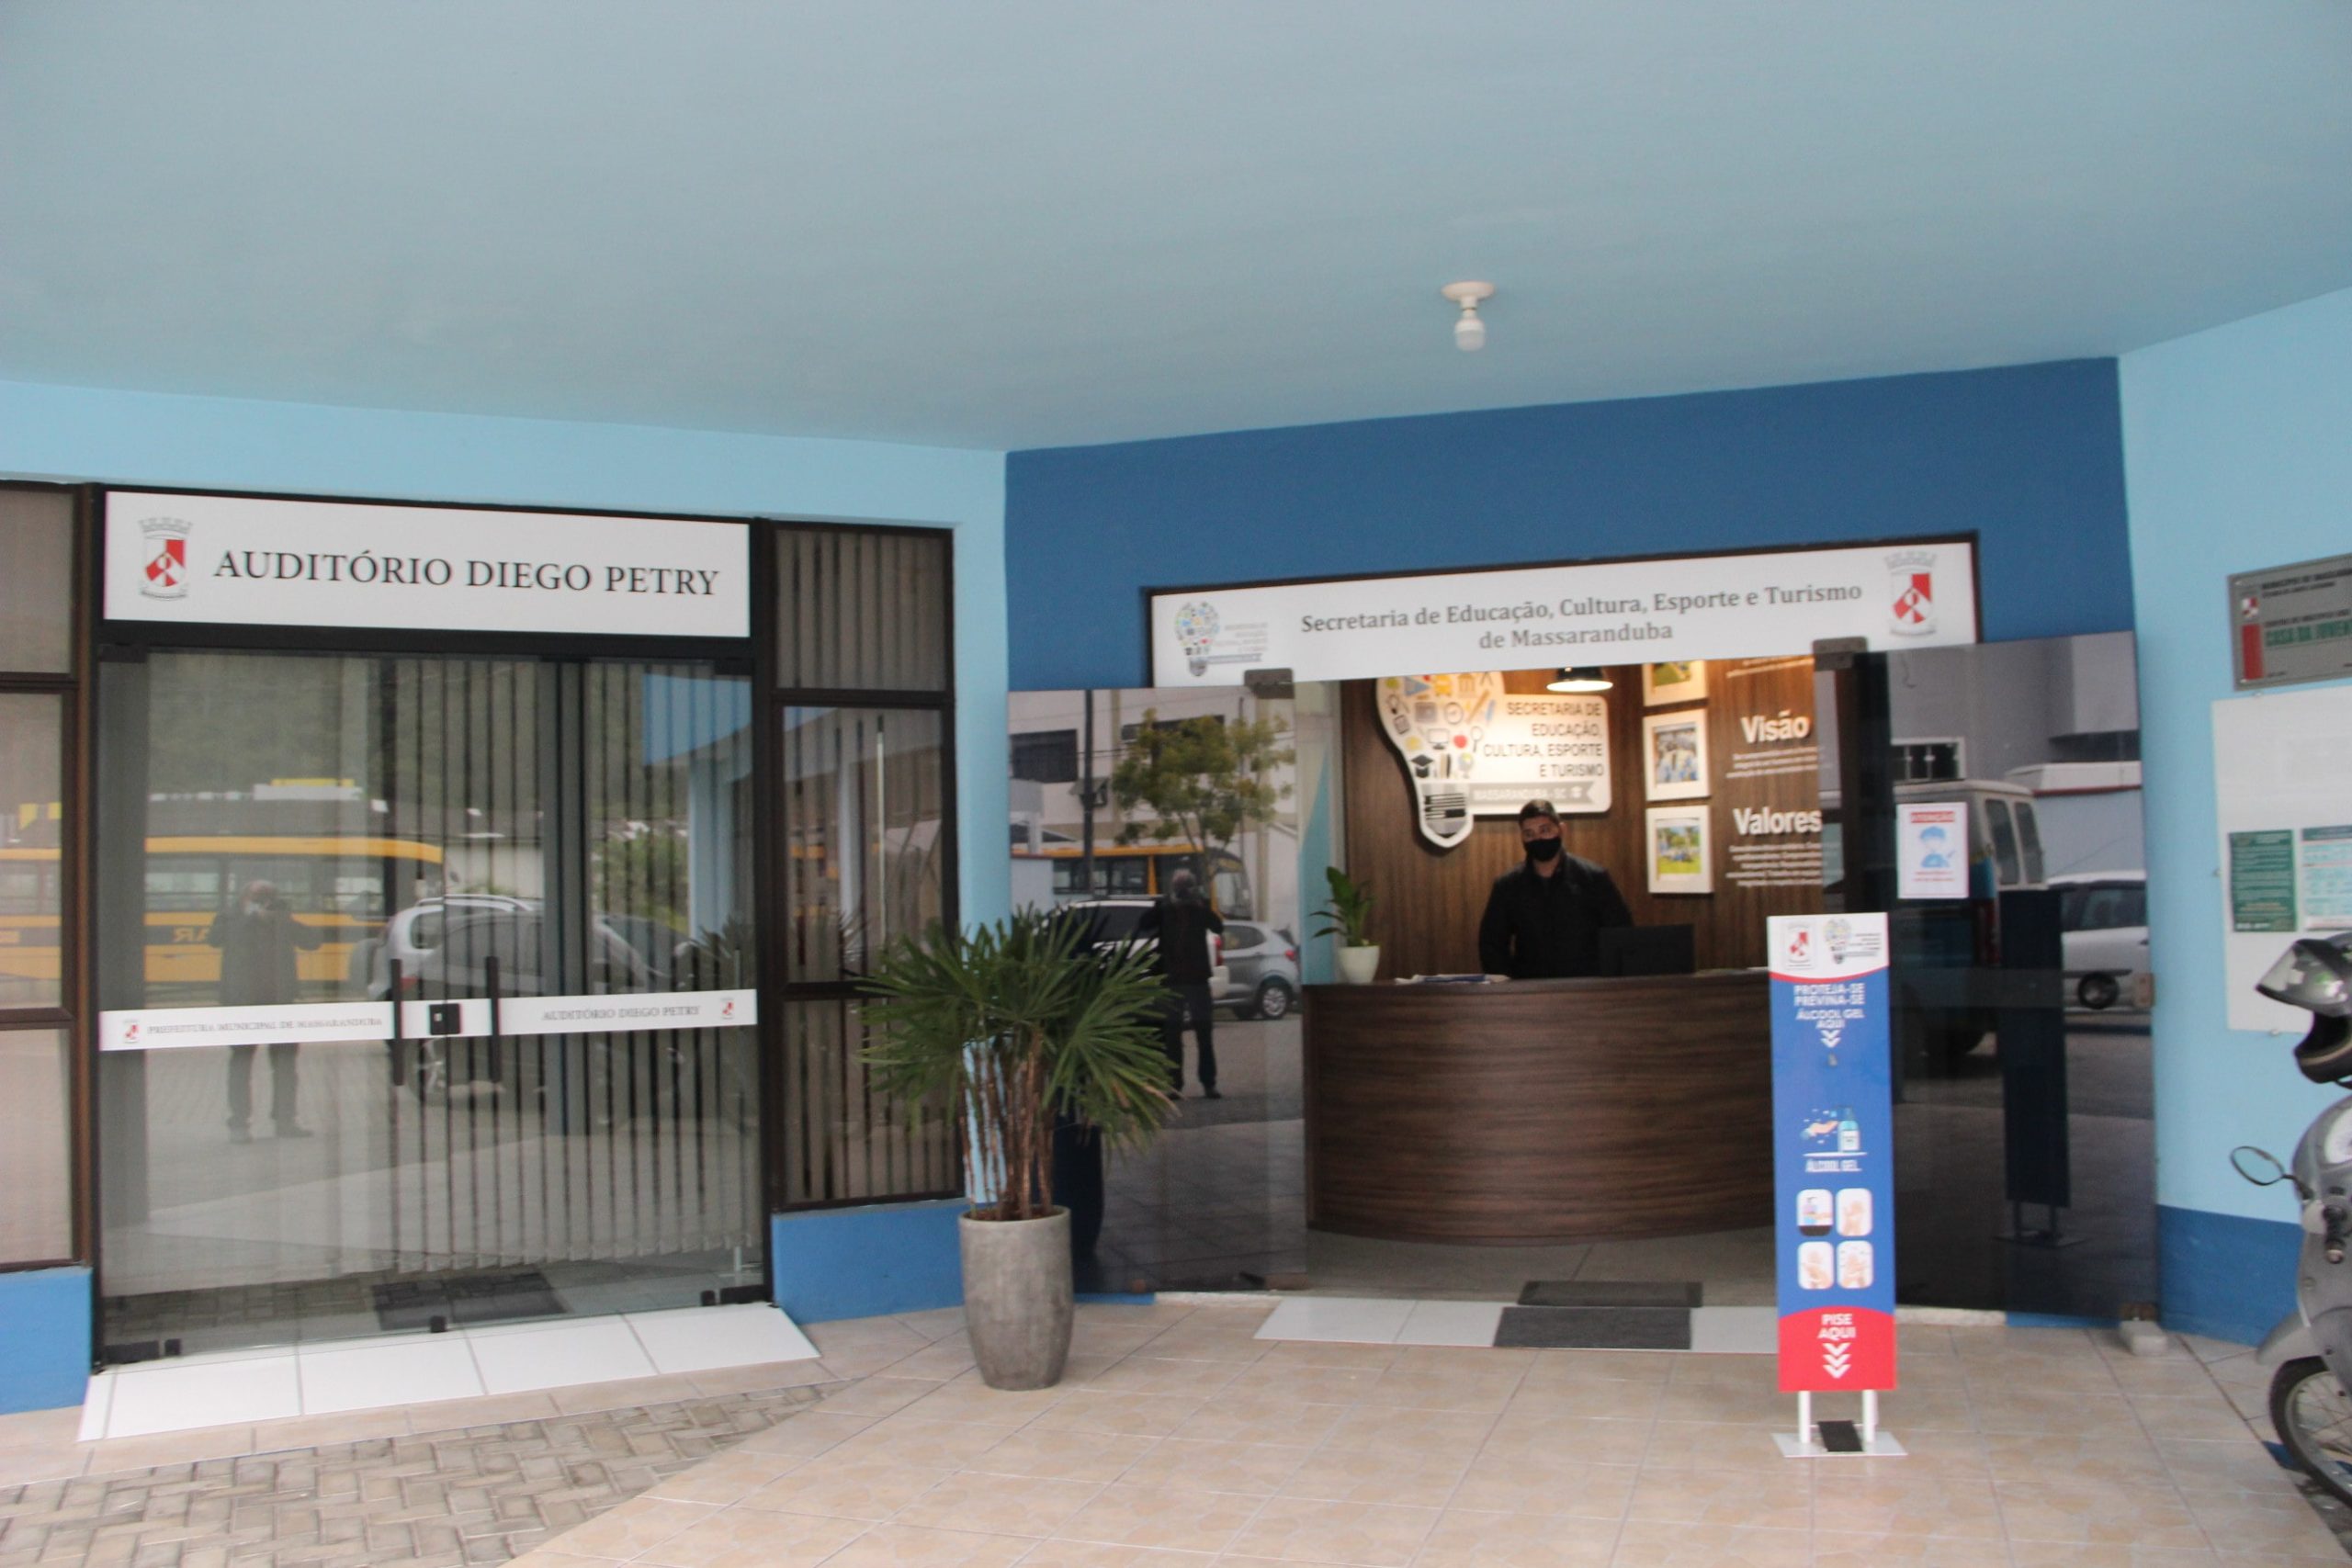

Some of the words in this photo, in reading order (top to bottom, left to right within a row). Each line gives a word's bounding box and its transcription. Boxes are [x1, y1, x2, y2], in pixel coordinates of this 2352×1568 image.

[214, 549, 453, 586] AUDITÓRIO
[467, 559, 592, 592] DIEGO
[606, 566, 719, 596] PETRY
[1301, 610, 1408, 632] Secretaria
[1421, 607, 1441, 625] de
[1446, 602, 1555, 624] Educação,
[1560, 597, 1647, 616] Cultura,
[1654, 591, 1739, 614] Esporte
[1747, 591, 1758, 605] e
[1765, 584, 1862, 606] Turismo
[1479, 631, 1505, 649] de
[1511, 622, 1674, 647] Massaranduba
[1507, 701, 1583, 716] SECRETARIA
[1586, 702, 1602, 716] DE
[1740, 709, 1810, 743] Visão
[1548, 743, 1603, 757] ESPORTE
[1539, 763, 1547, 777] E
[1552, 763, 1604, 777] TURISMO
[1732, 807, 1822, 836] Valores
[618, 1006, 661, 1019] DIEGO
[662, 1005, 701, 1017] PETRY
[1821, 1313, 1854, 1325] PISE
[1817, 1326, 1856, 1340] AQUI
